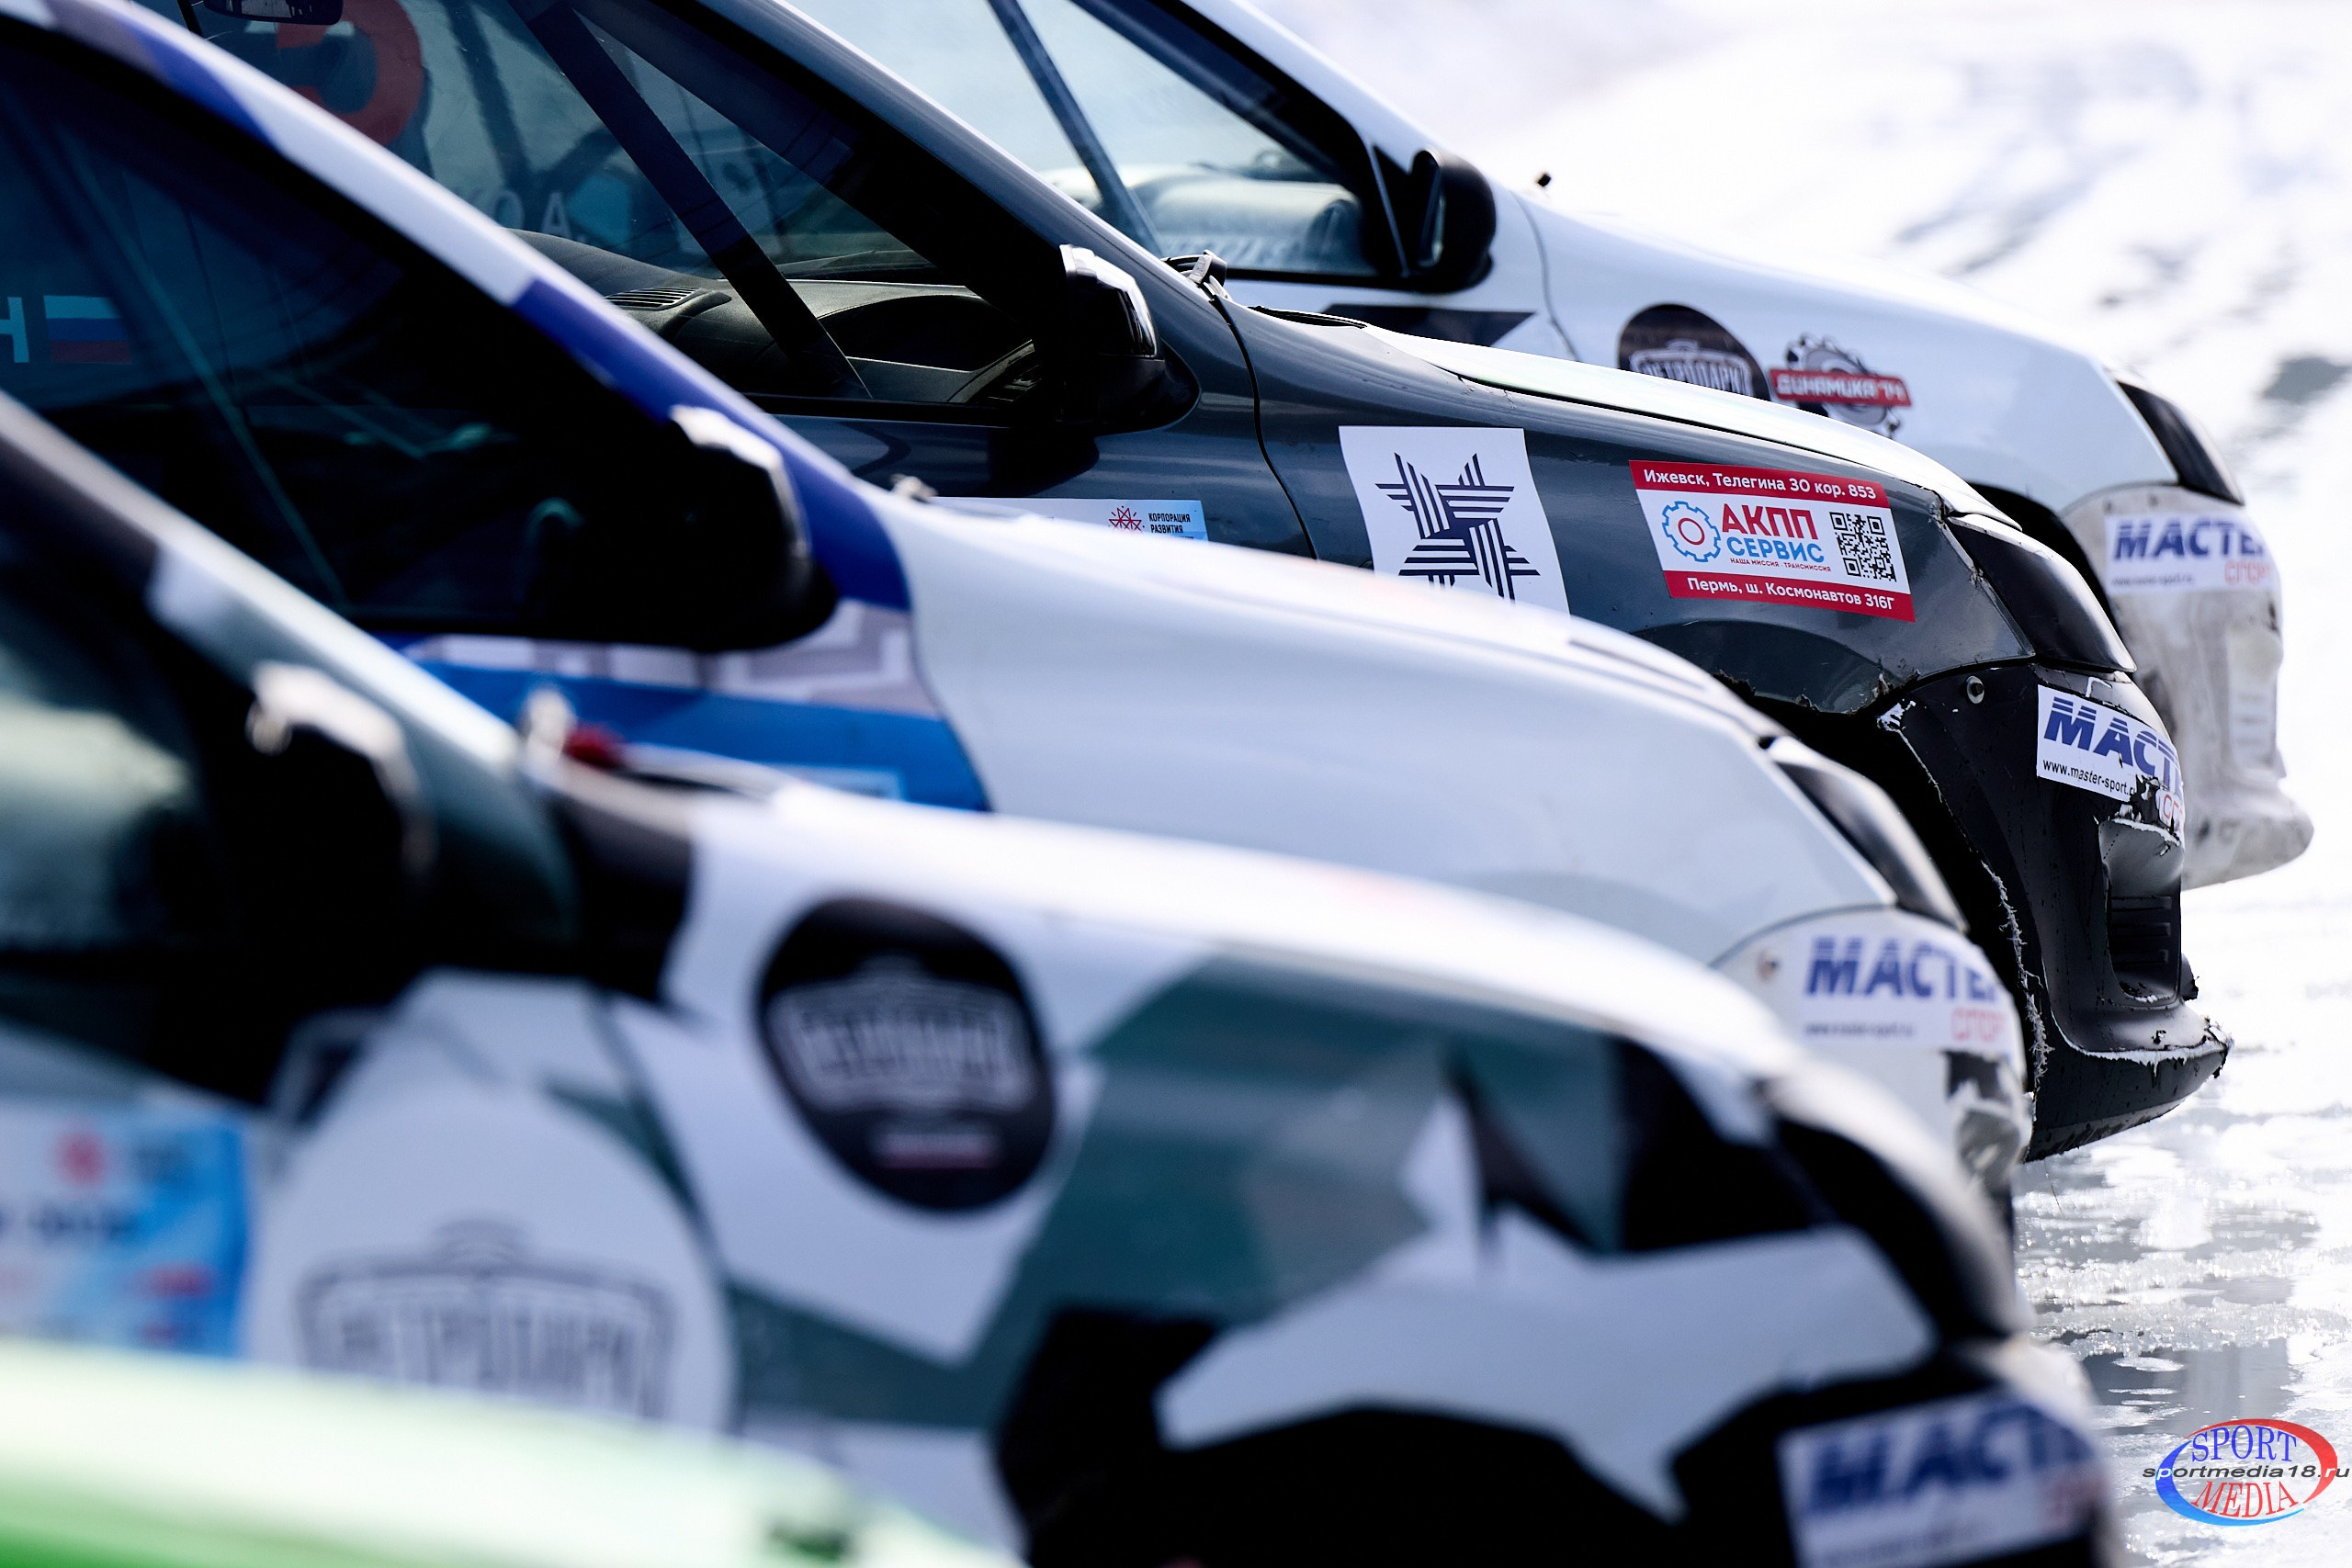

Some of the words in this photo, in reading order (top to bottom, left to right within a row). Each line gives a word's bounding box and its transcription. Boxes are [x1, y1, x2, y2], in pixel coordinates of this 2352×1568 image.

[1644, 468, 1710, 487] Ижевск,
[1713, 472, 1785, 491] Телегина
[1790, 480, 1811, 492] 30
[1815, 483, 1846, 499] кор.
[1848, 484, 1876, 499] 853
[1148, 513, 1191, 523] КОРПОРАЦИЯ
[1150, 524, 1183, 534] РАЗВИТИЯ
[1722, 503, 1819, 540] АКПП
[1726, 536, 1825, 563] СЕРВИС
[1730, 558, 1751, 566] НАША
[1751, 559, 1780, 568] МИССИЯ
[1783, 561, 1832, 572] ТРАНСМИССИЯ
[1688, 577, 1743, 595] Пермь,
[1746, 582, 1764, 595] ш.
[1767, 581, 1861, 605] Космонавтов
[1864, 593, 1895, 611] 316Г
